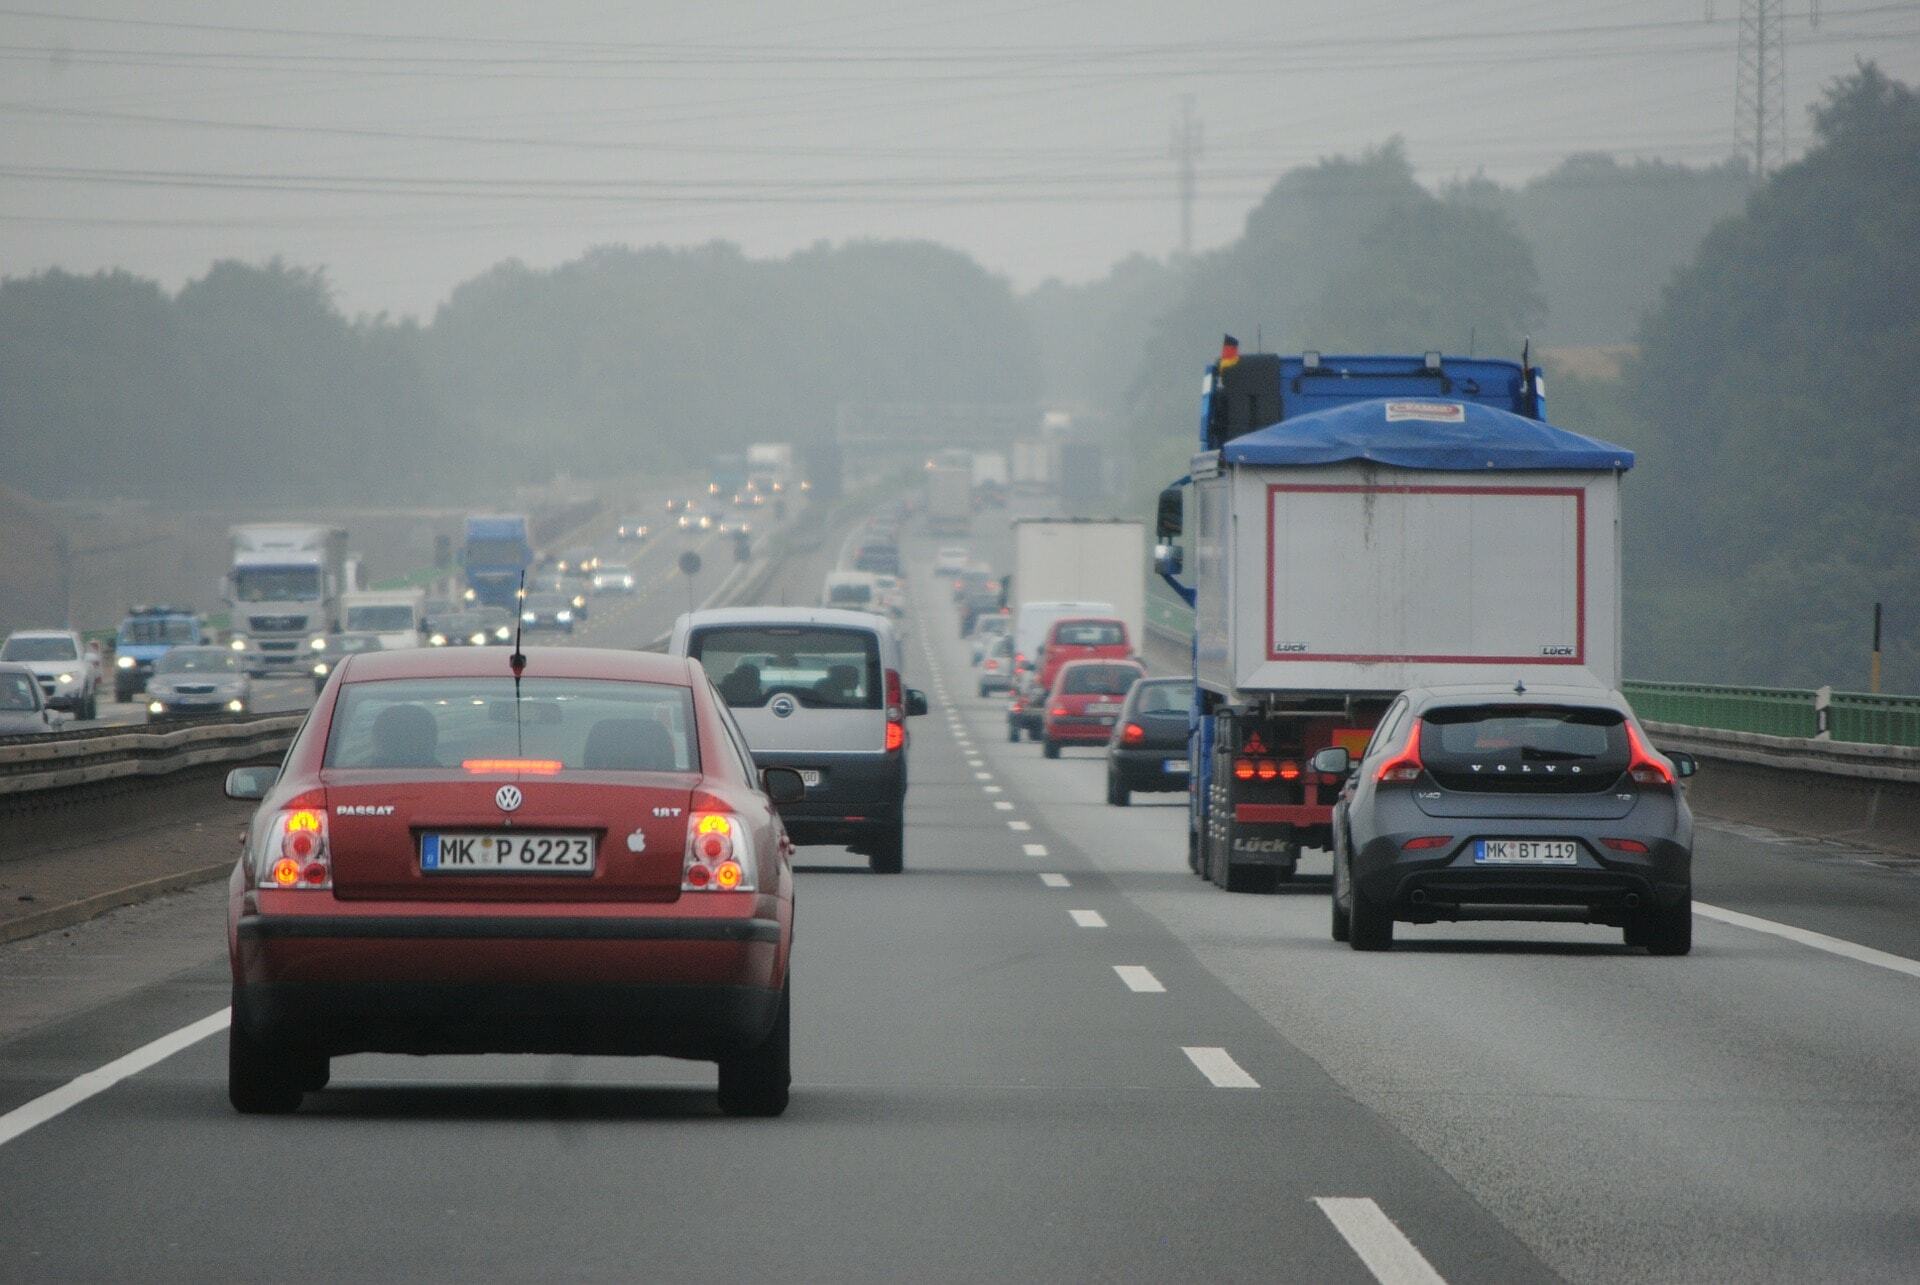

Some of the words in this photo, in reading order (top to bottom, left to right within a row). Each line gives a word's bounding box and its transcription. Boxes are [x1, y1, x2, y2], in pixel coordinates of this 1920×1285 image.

[1471, 764, 1581, 773] VOLVO
[336, 805, 395, 816] PASSAT
[440, 840, 475, 864] MK
[497, 840, 512, 864] P
[520, 840, 588, 865] 6223
[1486, 842, 1507, 858] MK
[1519, 843, 1540, 858] BT
[1544, 843, 1575, 859] 119
